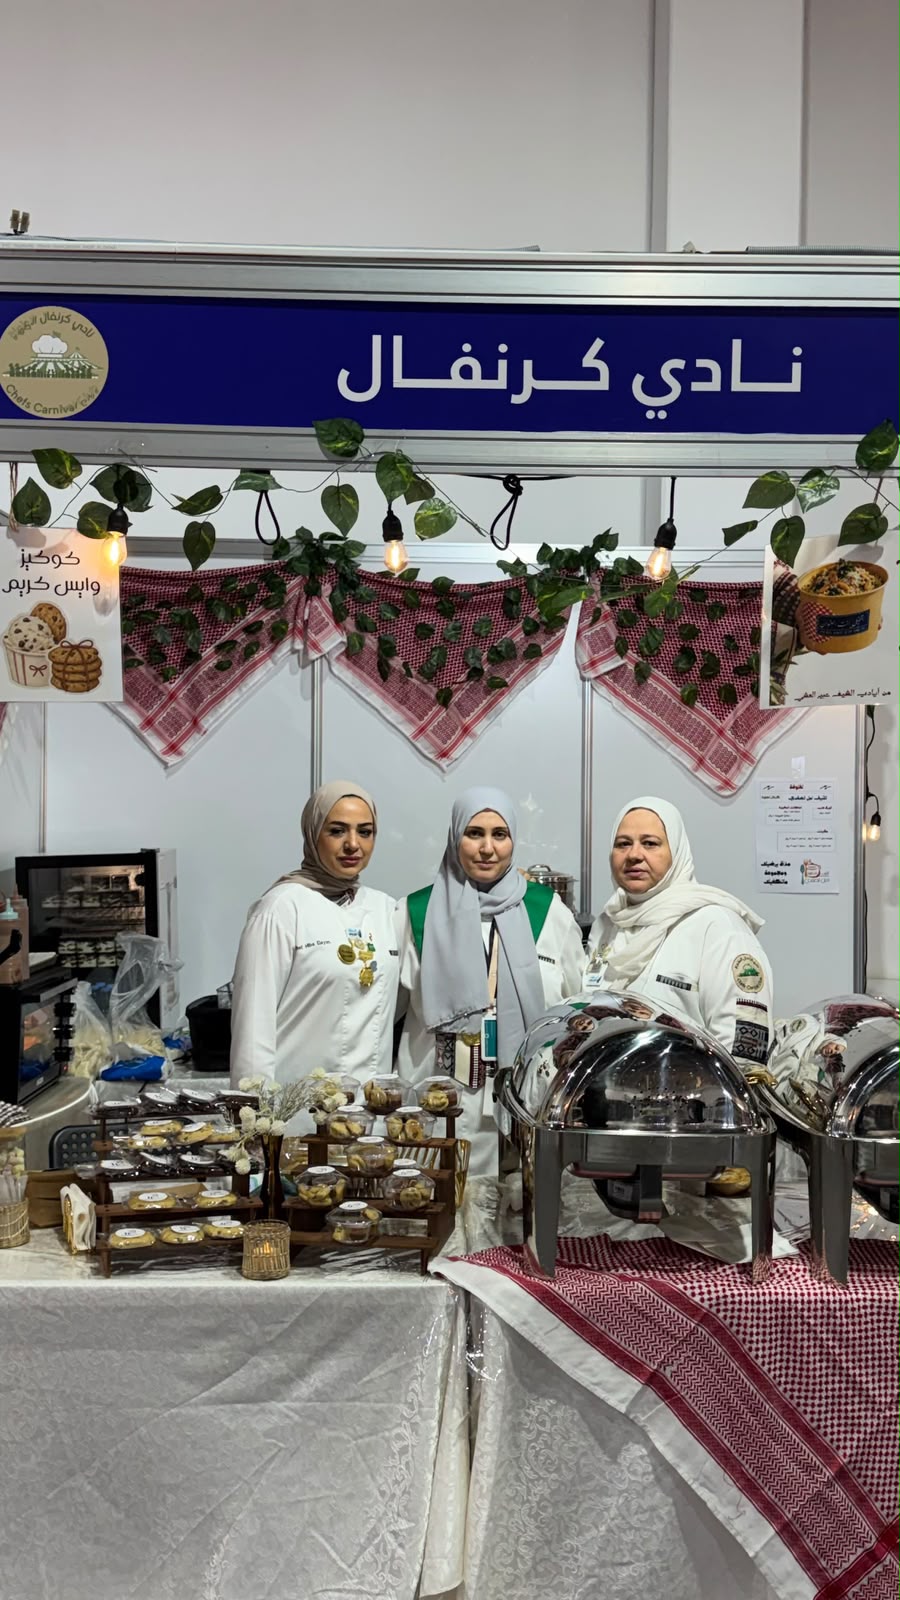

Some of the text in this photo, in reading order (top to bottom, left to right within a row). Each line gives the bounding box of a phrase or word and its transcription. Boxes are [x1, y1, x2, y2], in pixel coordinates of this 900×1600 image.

[337, 335, 803, 420] نادي كرنفال
[20, 548, 81, 571] كوكيز
[2, 576, 101, 599] وايس كريم
[832, 689, 855, 699] الشيف
